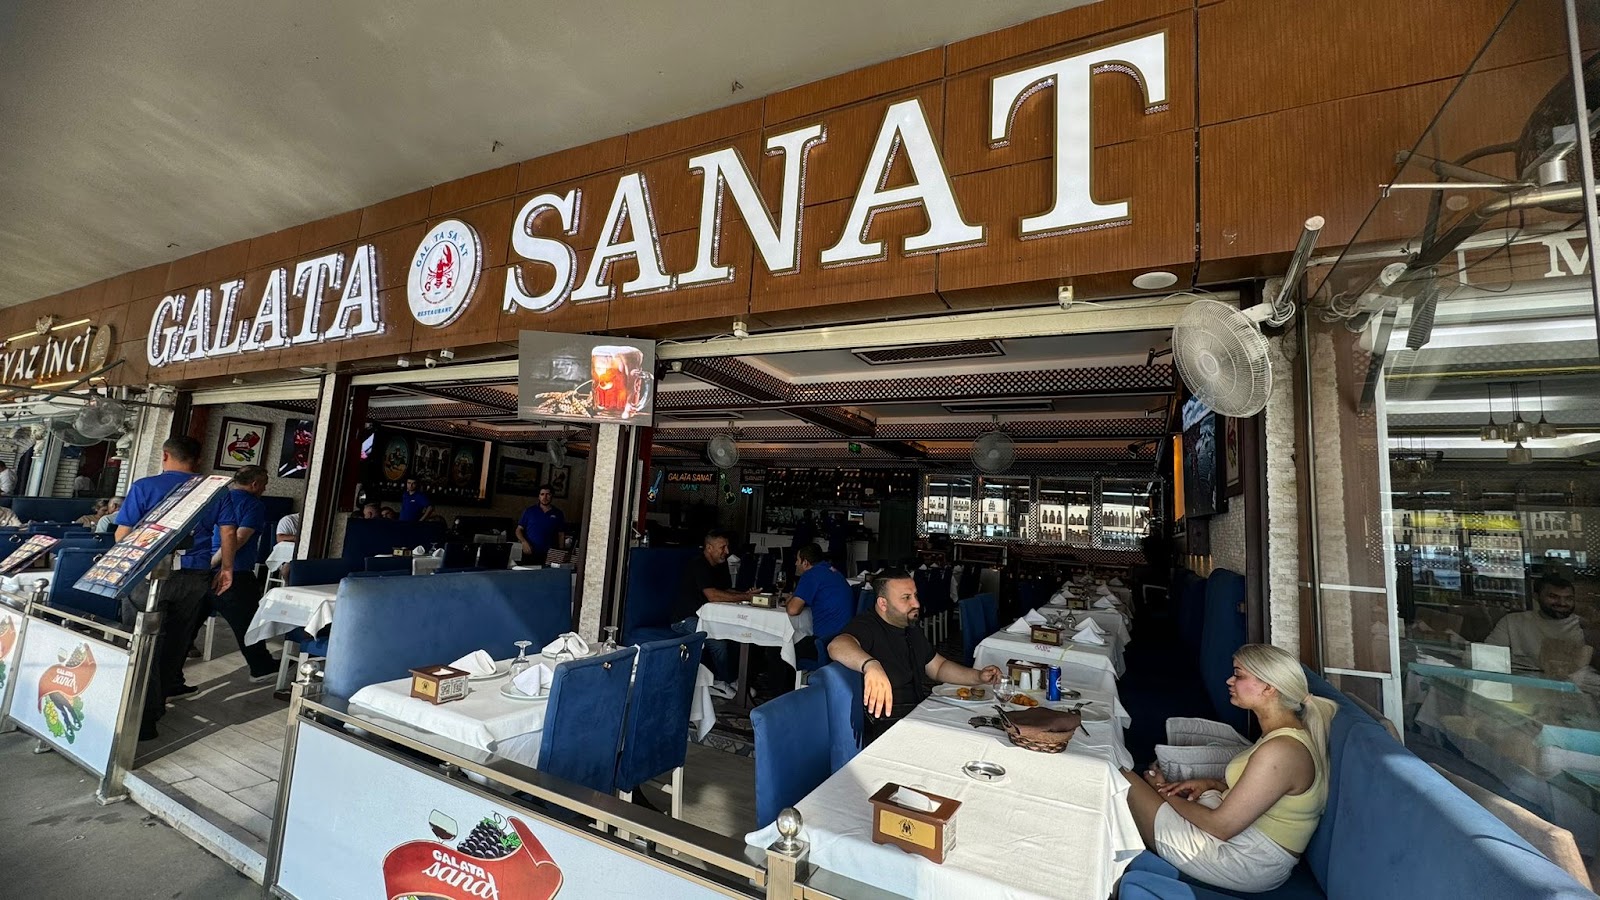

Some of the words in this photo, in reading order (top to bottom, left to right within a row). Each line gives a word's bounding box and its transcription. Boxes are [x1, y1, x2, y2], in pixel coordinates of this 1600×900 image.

[147, 243, 385, 368] GALATA
[503, 32, 1168, 312] SANAT
[417, 306, 453, 317] RESTAURANT
[40, 326, 92, 379] İNCİ
[668, 473, 690, 481] GALATA
[691, 473, 713, 482] SANAT
[432, 850, 485, 879] GALATA
